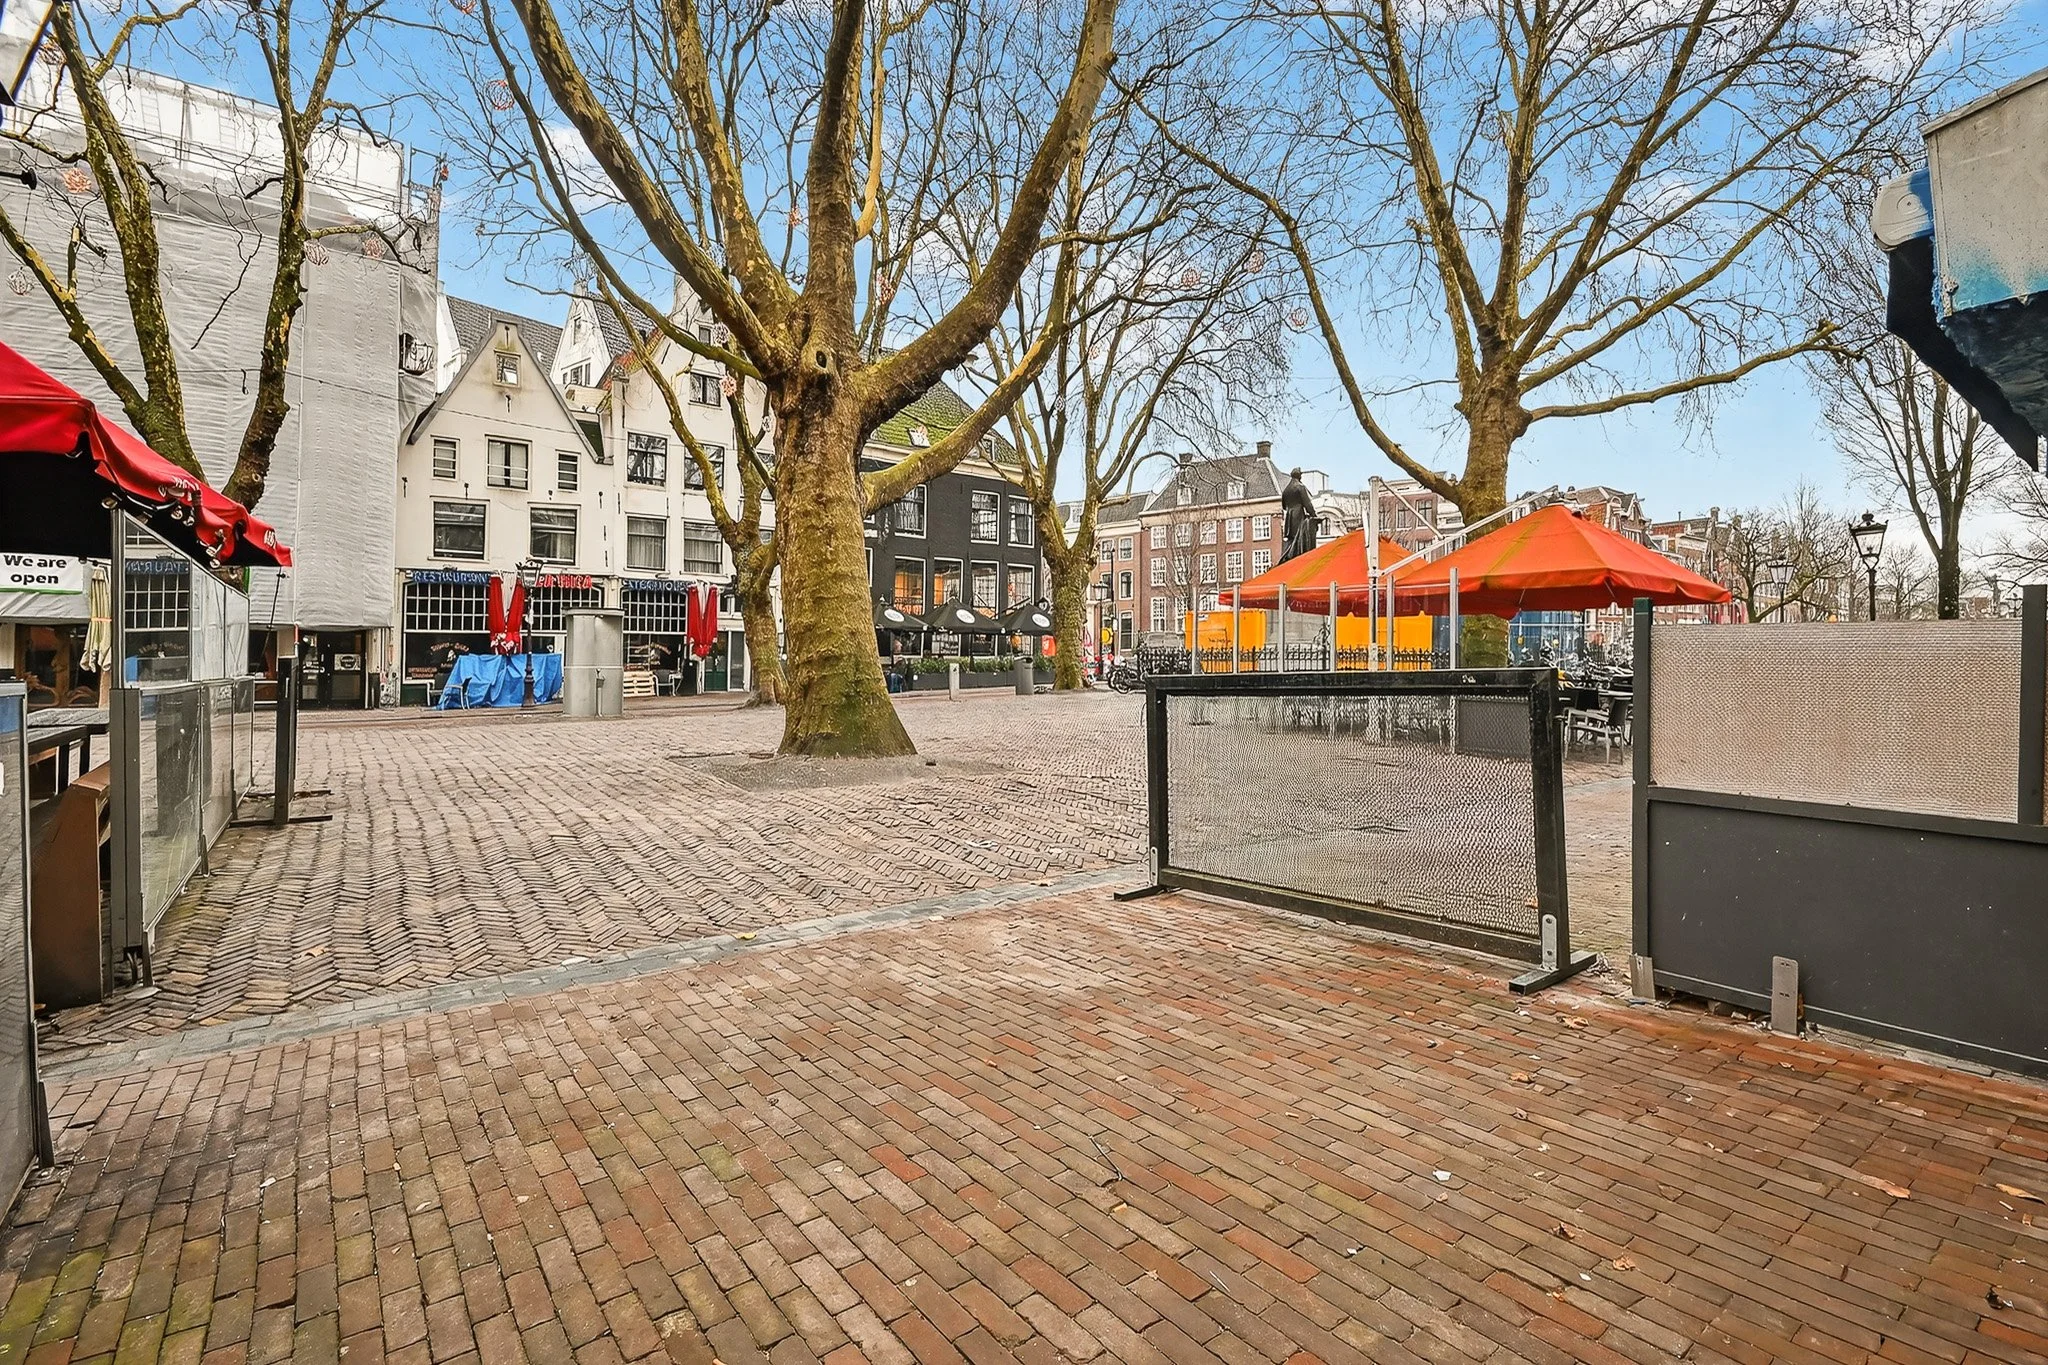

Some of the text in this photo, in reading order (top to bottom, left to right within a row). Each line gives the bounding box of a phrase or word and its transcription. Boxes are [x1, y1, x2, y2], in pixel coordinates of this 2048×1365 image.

[3, 554, 67, 569] We are
[10, 573, 59, 586] open
